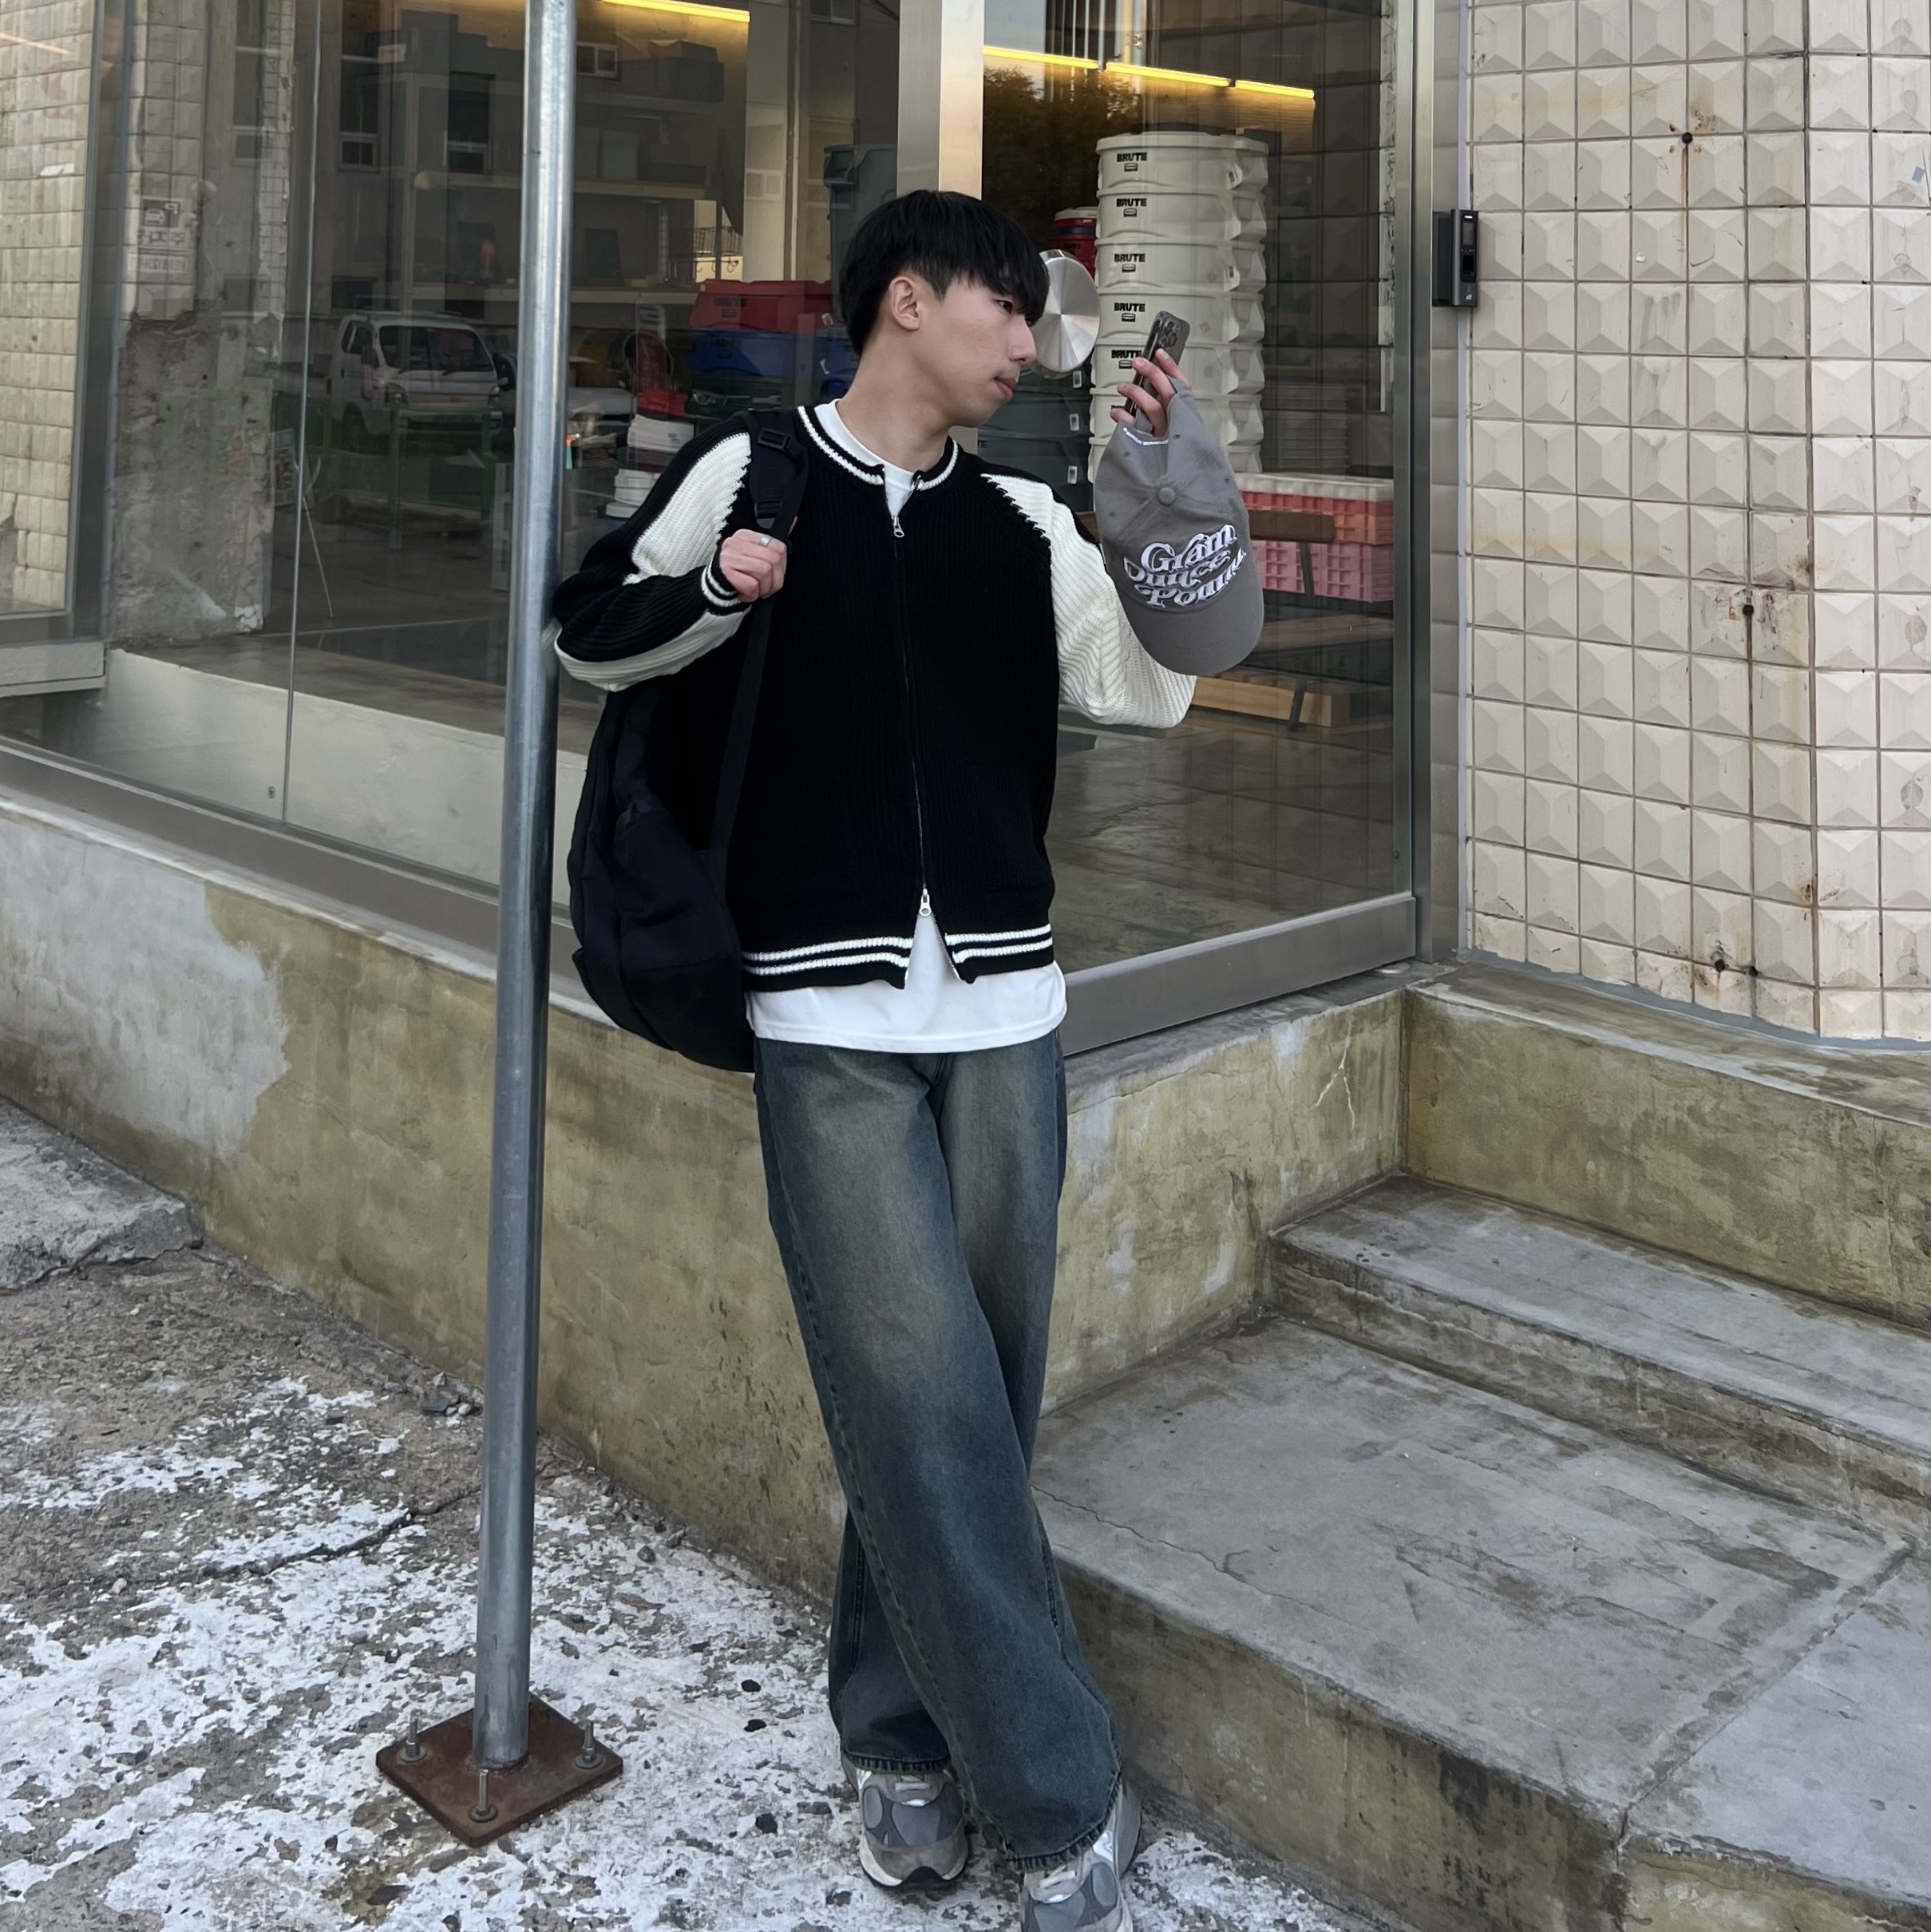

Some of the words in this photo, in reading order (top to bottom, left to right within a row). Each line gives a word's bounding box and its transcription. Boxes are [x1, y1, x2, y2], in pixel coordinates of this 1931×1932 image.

[1117, 152, 1147, 162] BRUTE
[1117, 198, 1147, 208] BRUTE
[1114, 253, 1146, 263] BRUTE
[1114, 303, 1146, 312] BRUTE
[1141, 525, 1238, 572] Gram
